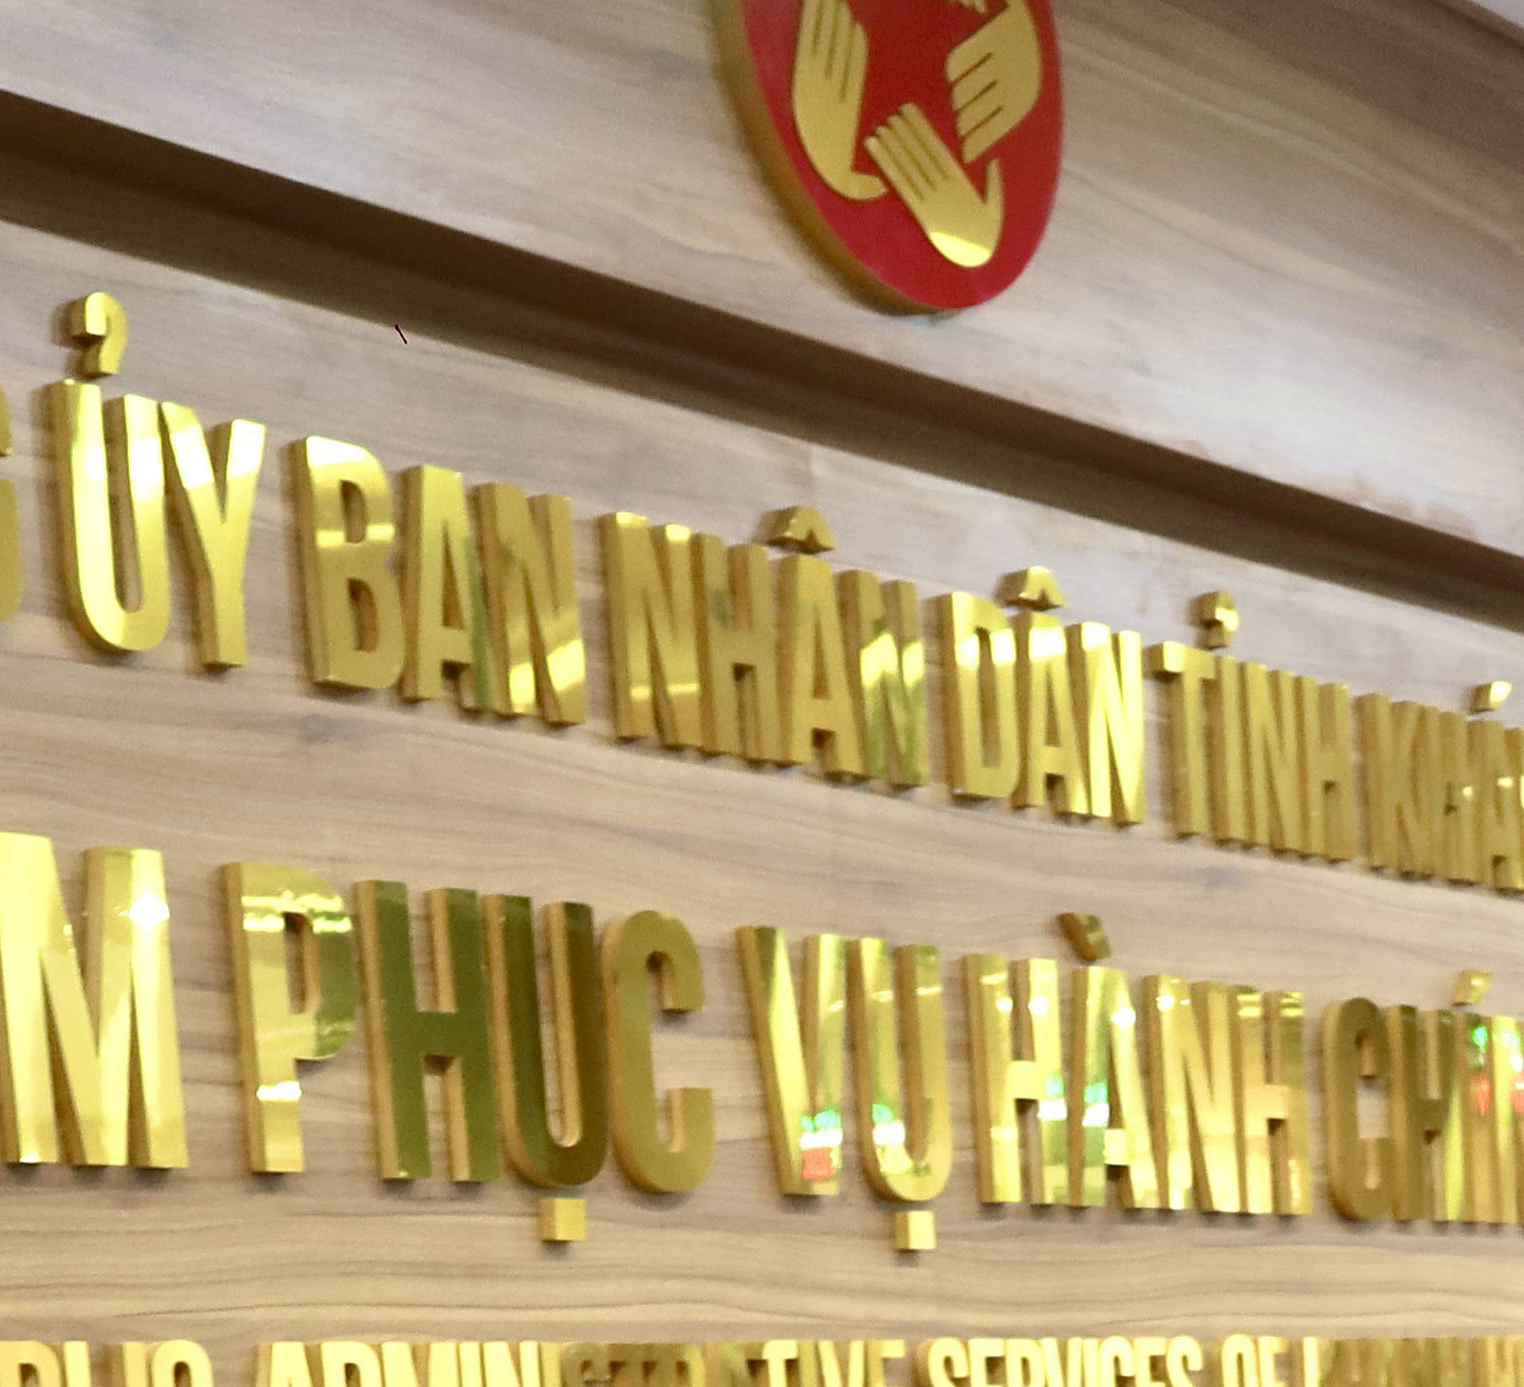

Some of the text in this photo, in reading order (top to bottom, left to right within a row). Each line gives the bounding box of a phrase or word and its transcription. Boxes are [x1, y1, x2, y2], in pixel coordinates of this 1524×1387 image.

[48, 291, 266, 669] ỦY
[292, 434, 586, 726] BAN
[599, 505, 928, 787] NHÂN
[926, 565, 1144, 825] DÂN
[1144, 591, 1357, 862] TỈNH
[226, 861, 716, 1242] PHỤC
[735, 925, 953, 1251] VỤ
[961, 911, 1314, 1216] HÀNH
